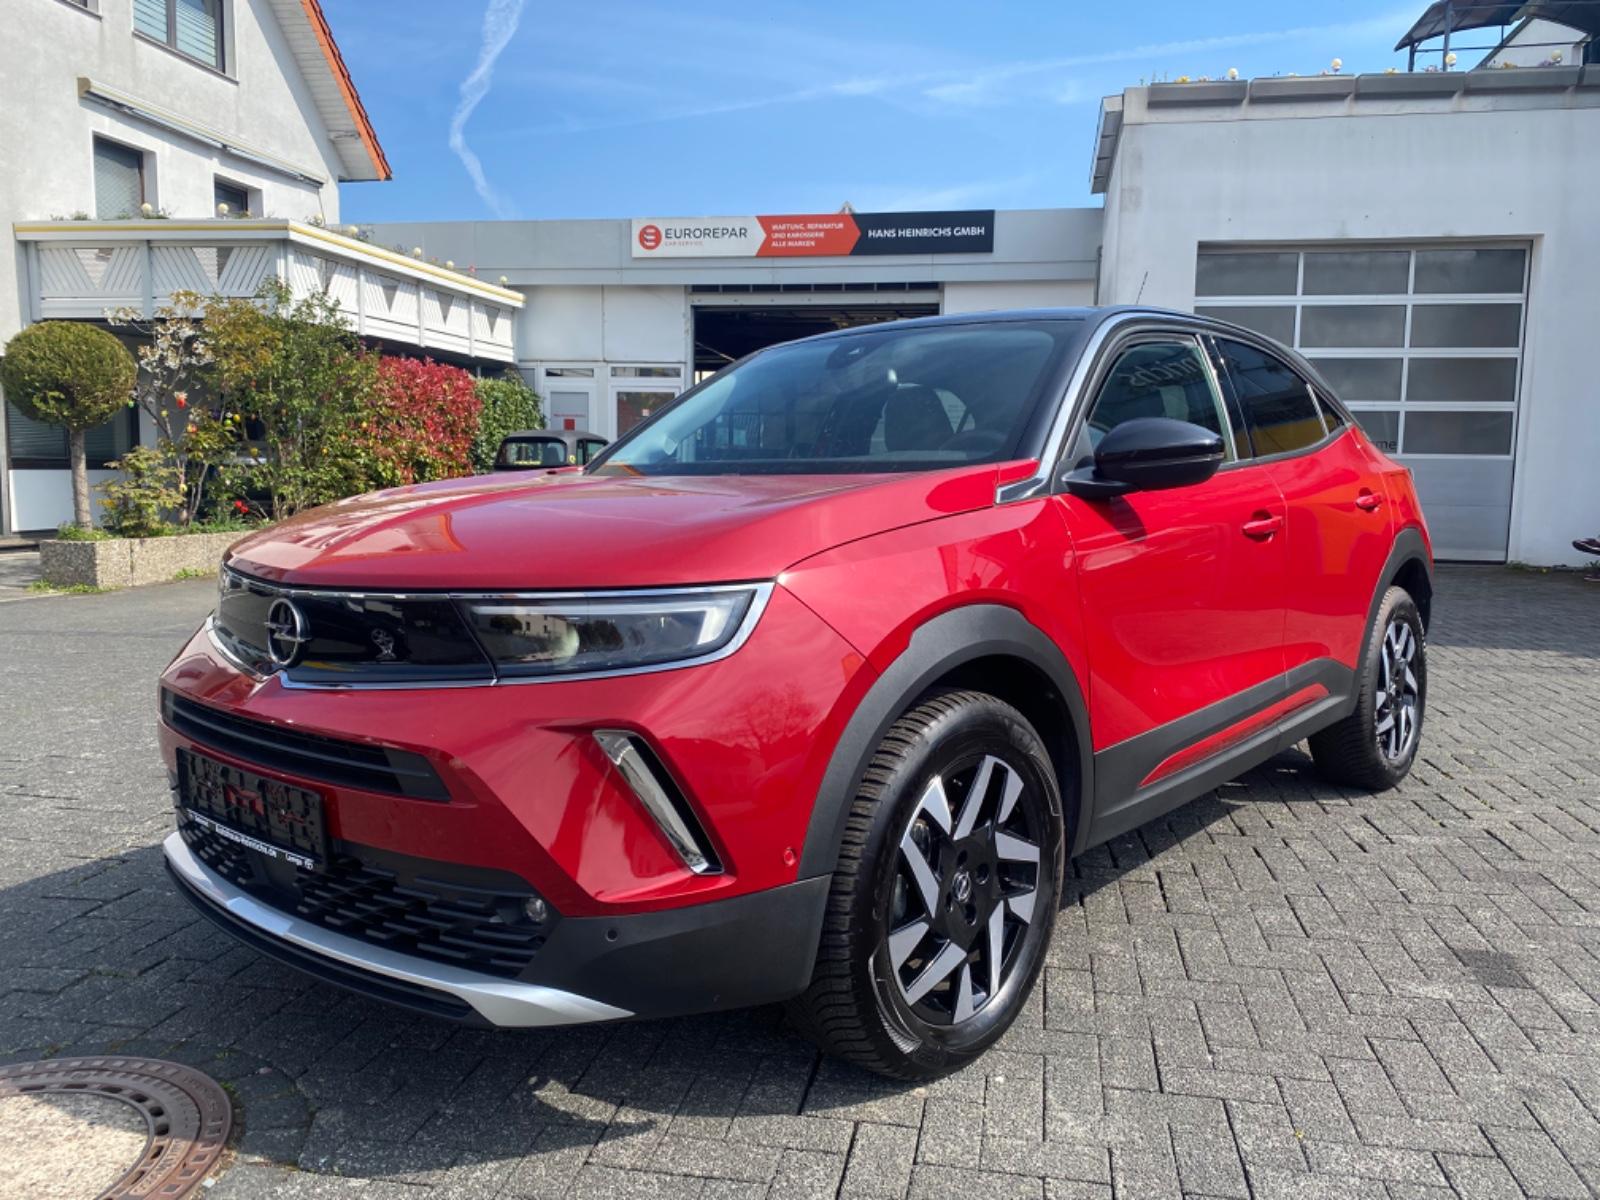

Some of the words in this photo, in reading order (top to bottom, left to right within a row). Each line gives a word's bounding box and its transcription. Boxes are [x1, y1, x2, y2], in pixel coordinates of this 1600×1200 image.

[807, 222, 844, 230] REPARATUR
[664, 227, 749, 239] EUROREPAR
[787, 231, 825, 239] KAROSSERIE
[867, 228, 896, 238] HANS
[897, 227, 951, 238] HEINRICHS
[953, 226, 985, 237] GMBH
